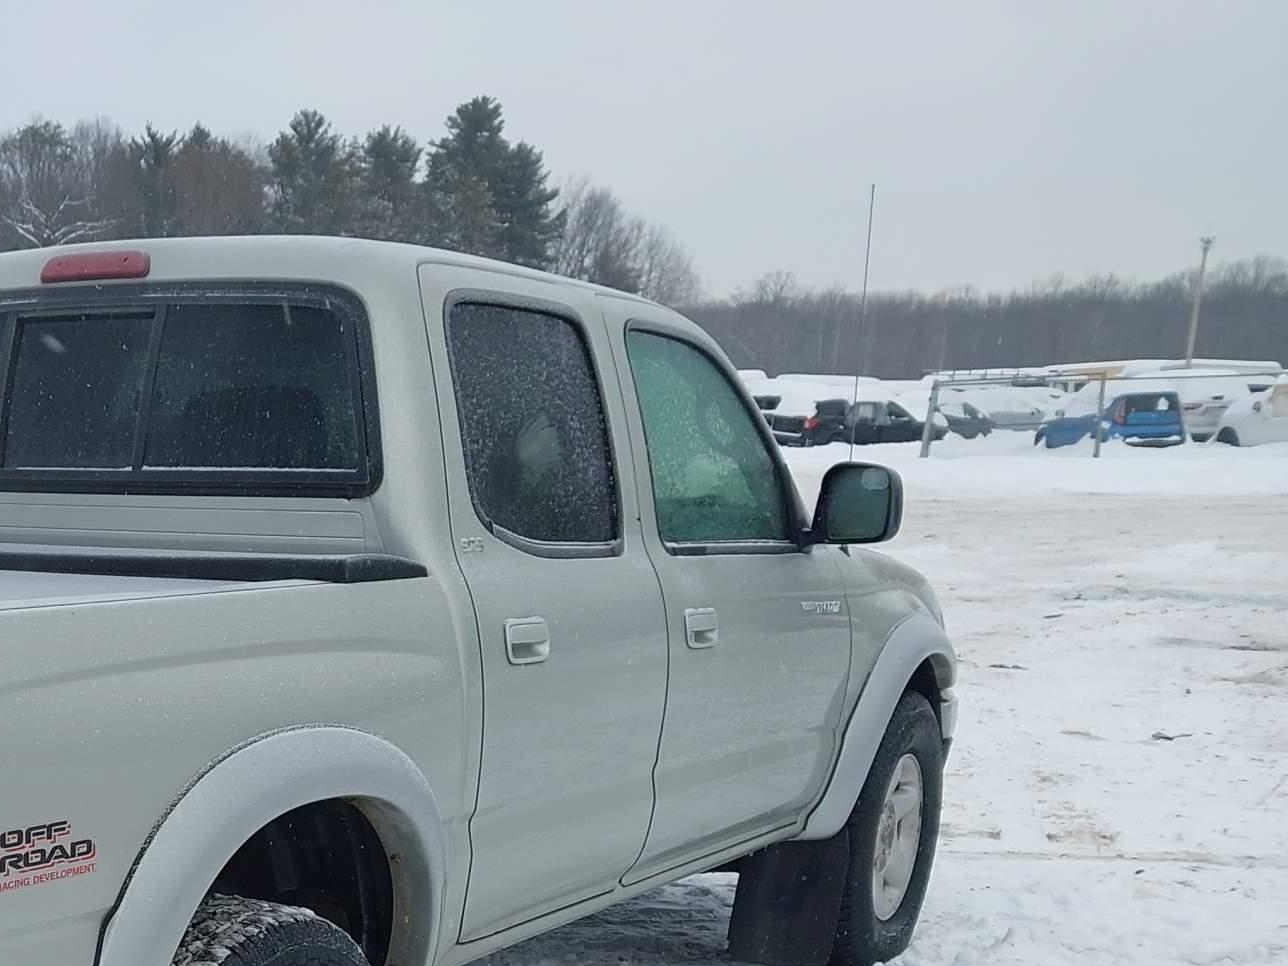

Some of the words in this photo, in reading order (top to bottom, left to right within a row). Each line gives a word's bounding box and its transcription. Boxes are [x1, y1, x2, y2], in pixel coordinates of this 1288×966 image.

[0, 820, 71, 852] OFF
[0, 839, 96, 876] ROAD
[32, 863, 96, 885] DEVELOPMENT
